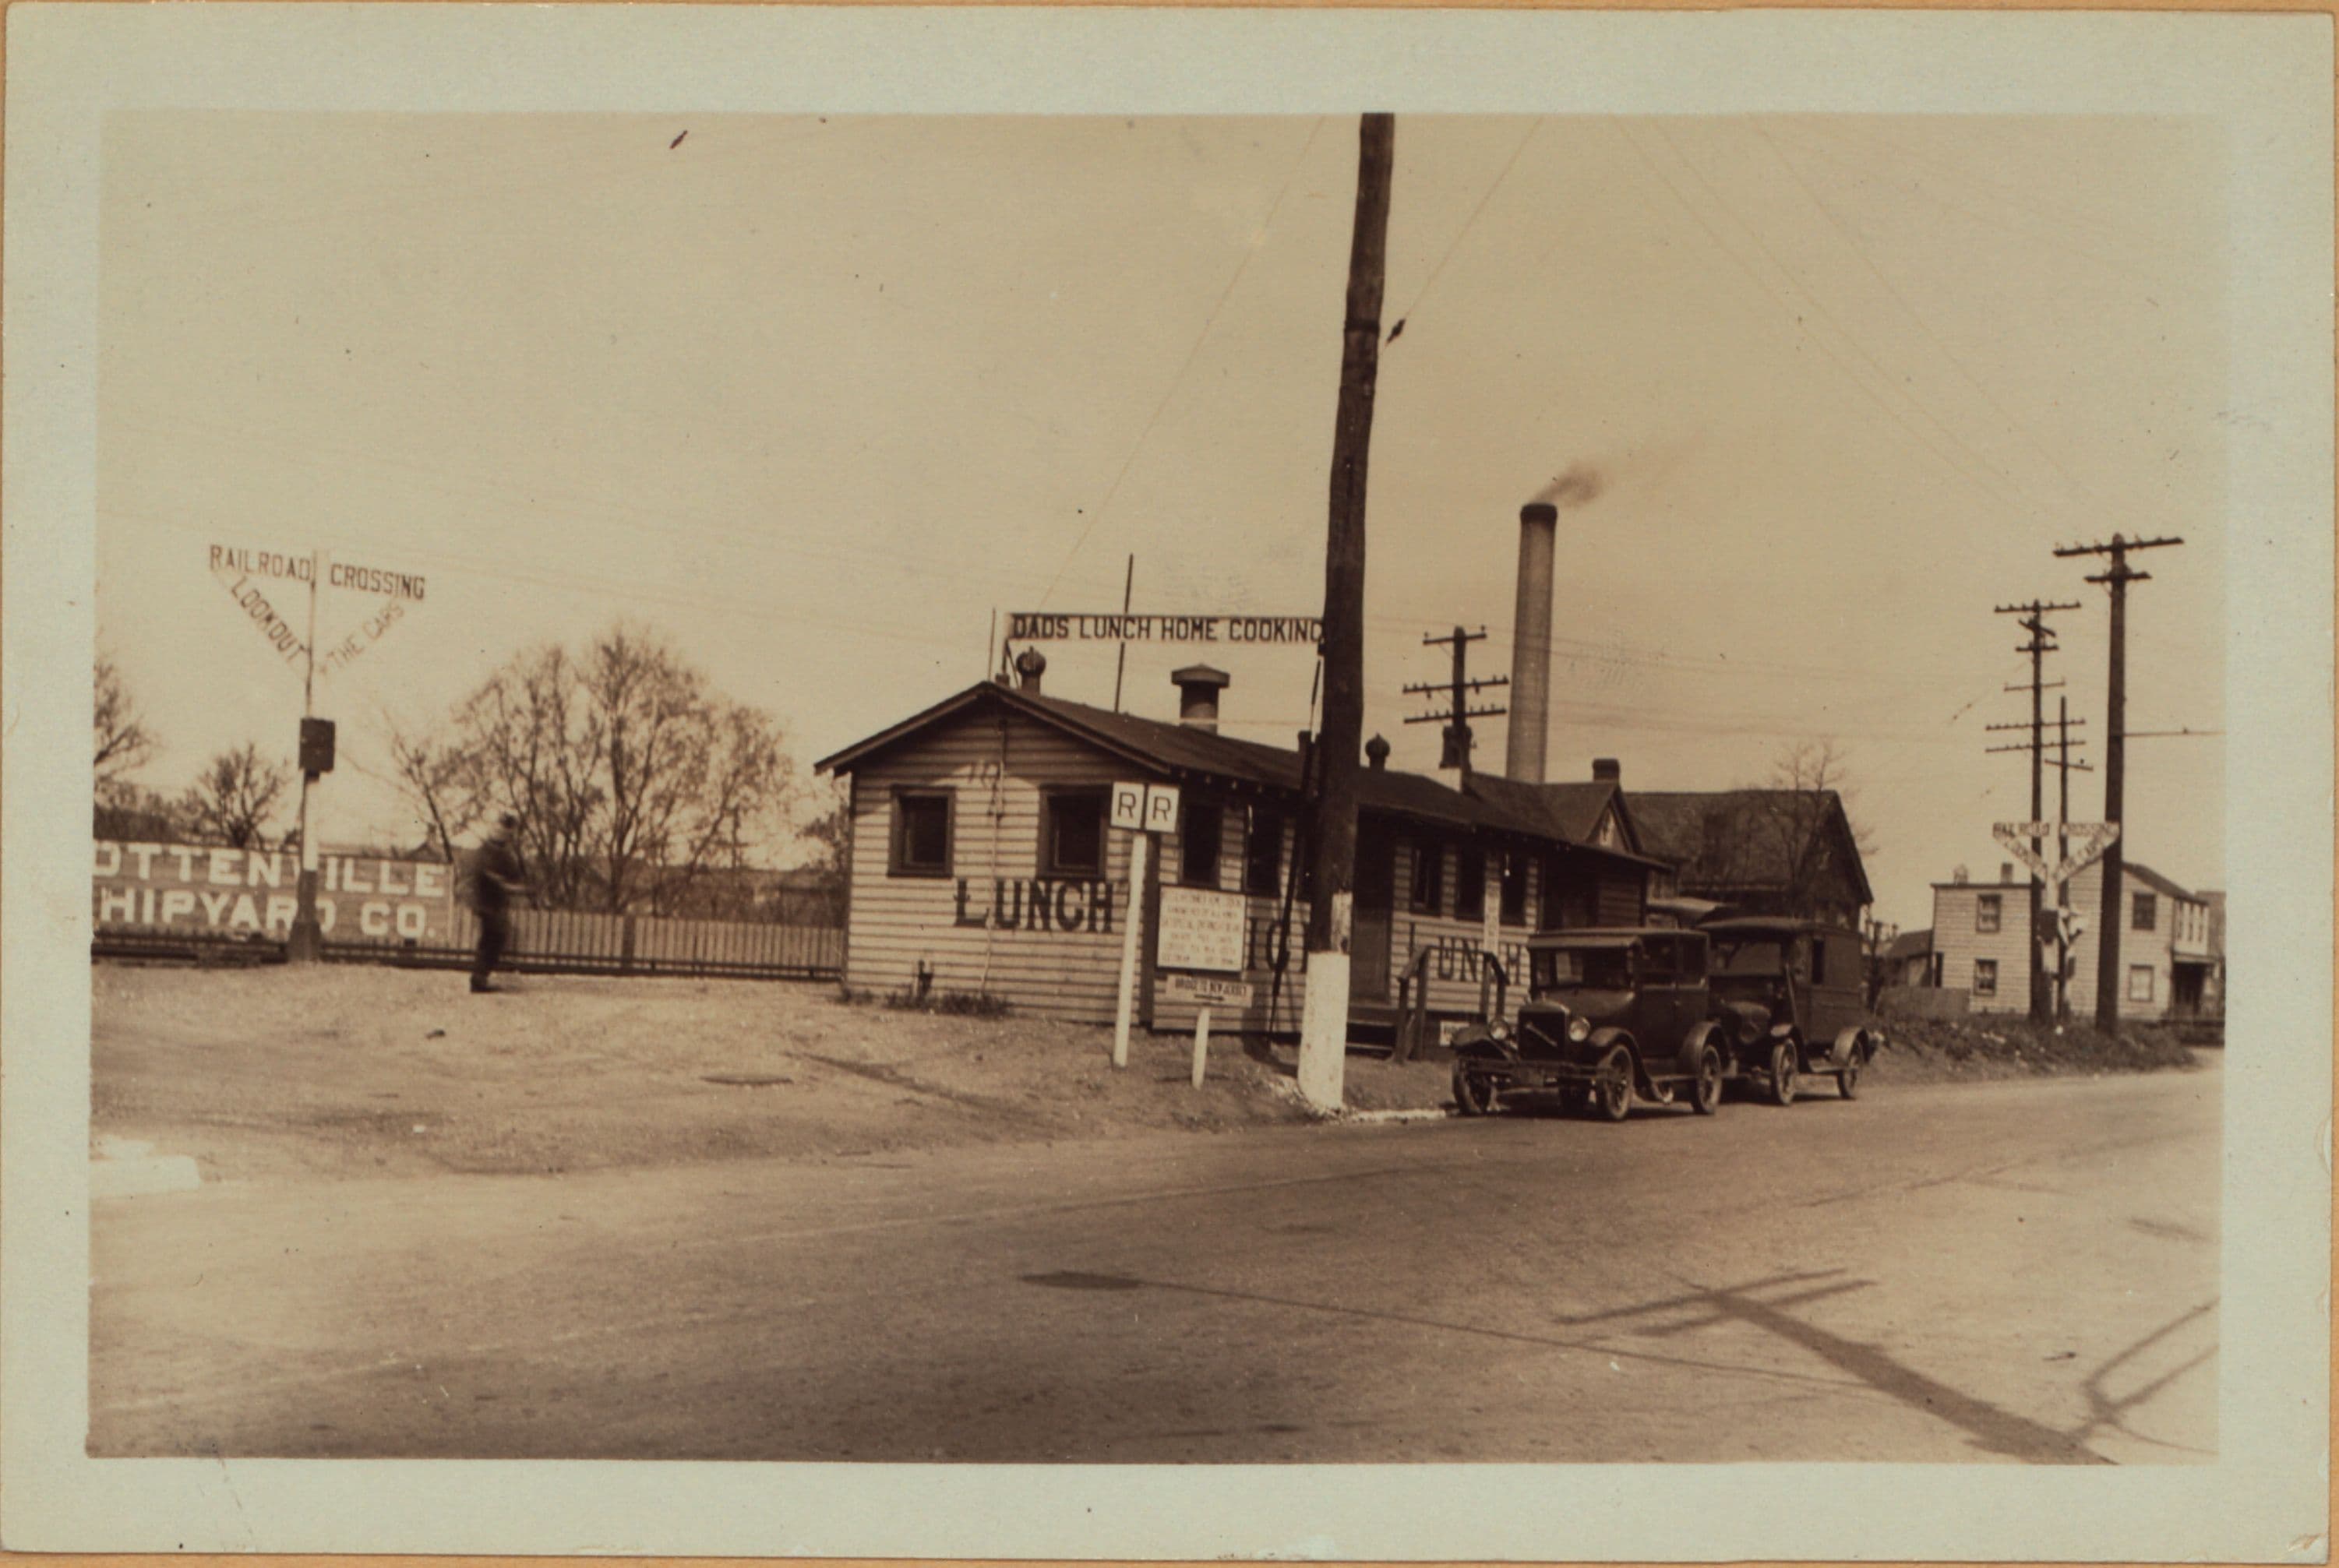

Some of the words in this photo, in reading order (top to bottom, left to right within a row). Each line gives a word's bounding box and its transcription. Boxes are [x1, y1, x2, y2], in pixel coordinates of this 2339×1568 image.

[210, 544, 311, 582] RAILROAD
[330, 563, 425, 601] CROSSING
[1013, 614, 1069, 640] DADS
[1080, 615, 1151, 640] LUNCH
[1161, 616, 1218, 640] HOME
[360, 902, 435, 938] CO.
[954, 879, 1113, 933] LUNCH
[1247, 915, 1309, 974] IC
[1409, 922, 1521, 985] UNH
